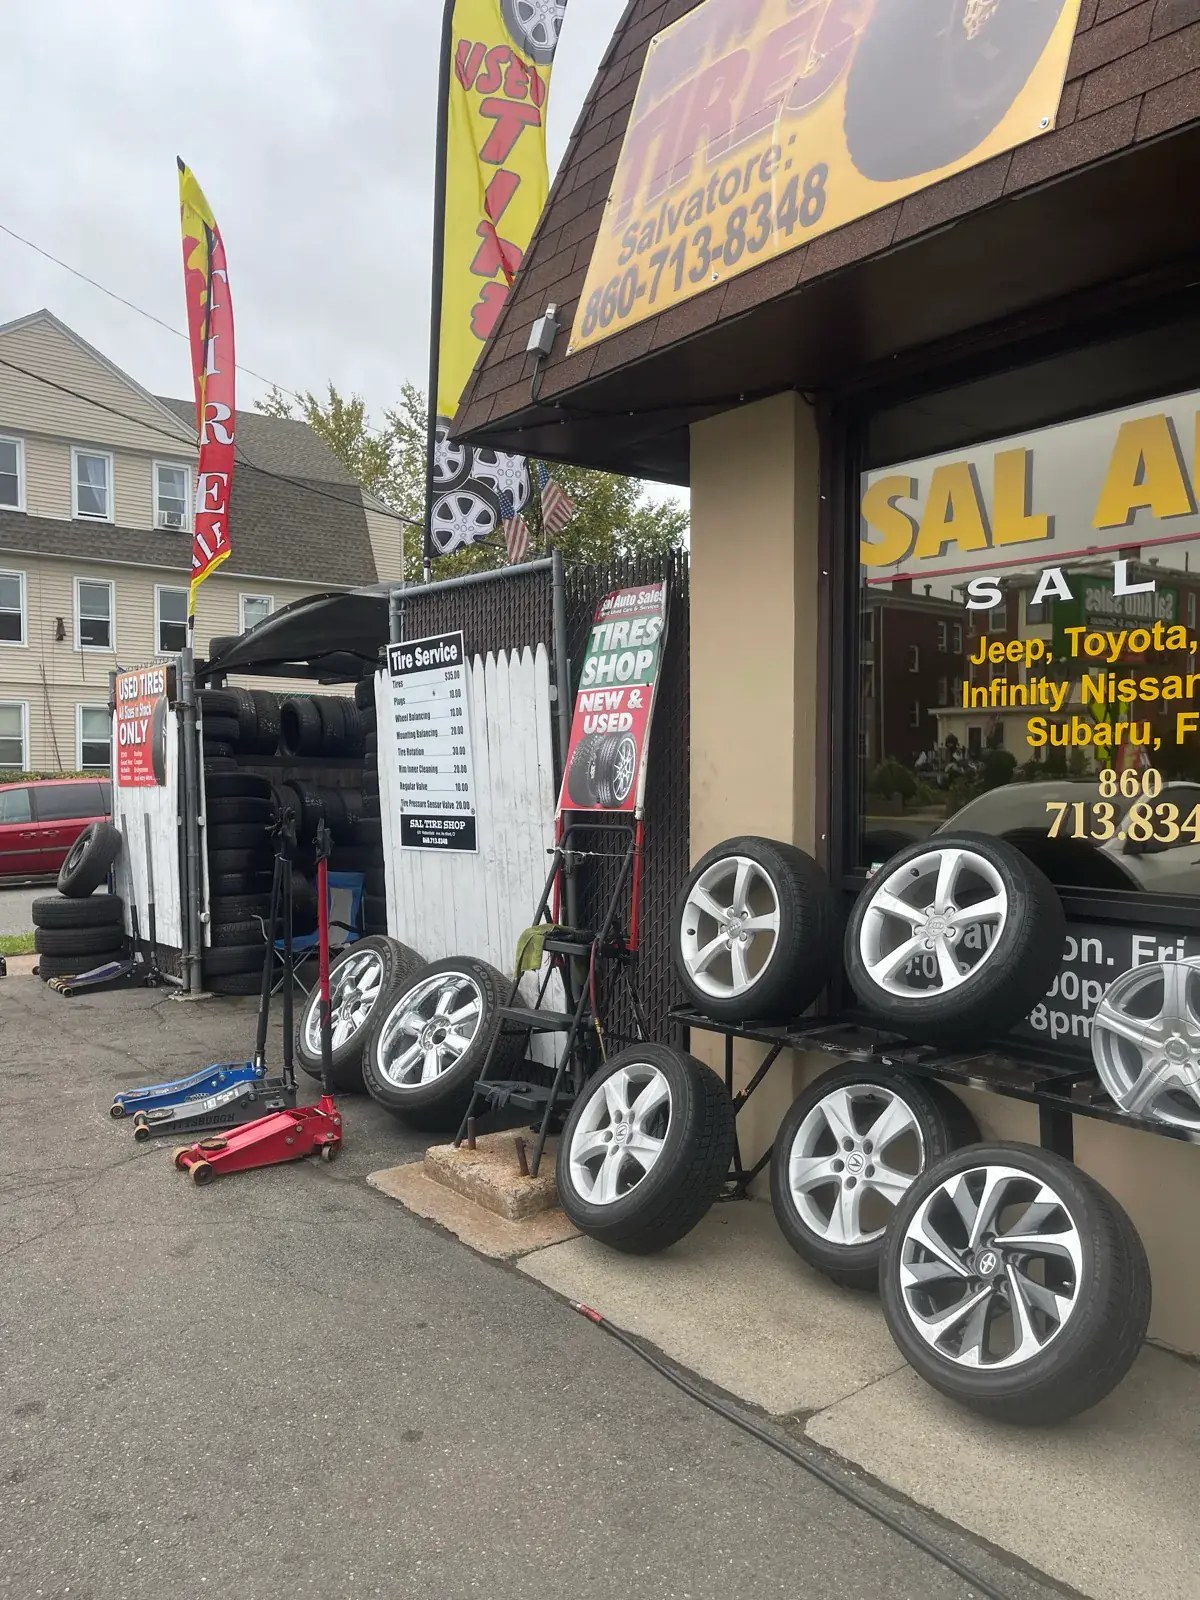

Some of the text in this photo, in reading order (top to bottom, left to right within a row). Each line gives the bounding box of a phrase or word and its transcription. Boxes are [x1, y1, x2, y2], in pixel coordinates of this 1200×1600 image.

[618, 134, 796, 266] Salvatore:
[580, 163, 829, 338] 860-713-8348
[861, 411, 1200, 568] SAL A
[613, 593, 636, 608] Auto
[591, 616, 664, 652] TIRES
[970, 620, 1198, 668] Jeep, Toyota,
[391, 642, 458, 670] Tire Service
[582, 650, 654, 685] SHOP
[120, 670, 164, 700] USED TIRES
[392, 670, 460, 689] Tires $35.00
[394, 689, 461, 706] Plugs 10.00
[579, 689, 643, 713] NEW &
[962, 676, 1076, 712] Infinity
[395, 707, 462, 723] Wheel Balancing 10.00
[583, 712, 633, 734] USED
[120, 719, 148, 746] ONLY
[416, 729, 438, 739] Balancing
[1026, 715, 1162, 749] Subaru,
[398, 748, 406, 756] Tire
[406, 747, 424, 756] Rotation
[419, 764, 438, 774] Cleaning
[400, 782, 469, 792] Regular Valve 10.00
[1098, 768, 1162, 798] 860
[409, 799, 426, 808] Pressure
[427, 800, 441, 809] Sensor
[442, 801, 454, 810] Valve
[455, 800, 470, 810] 20.00
[409, 819, 466, 830] SAL TIRE SHOP
[1061, 935, 1114, 966] on.
